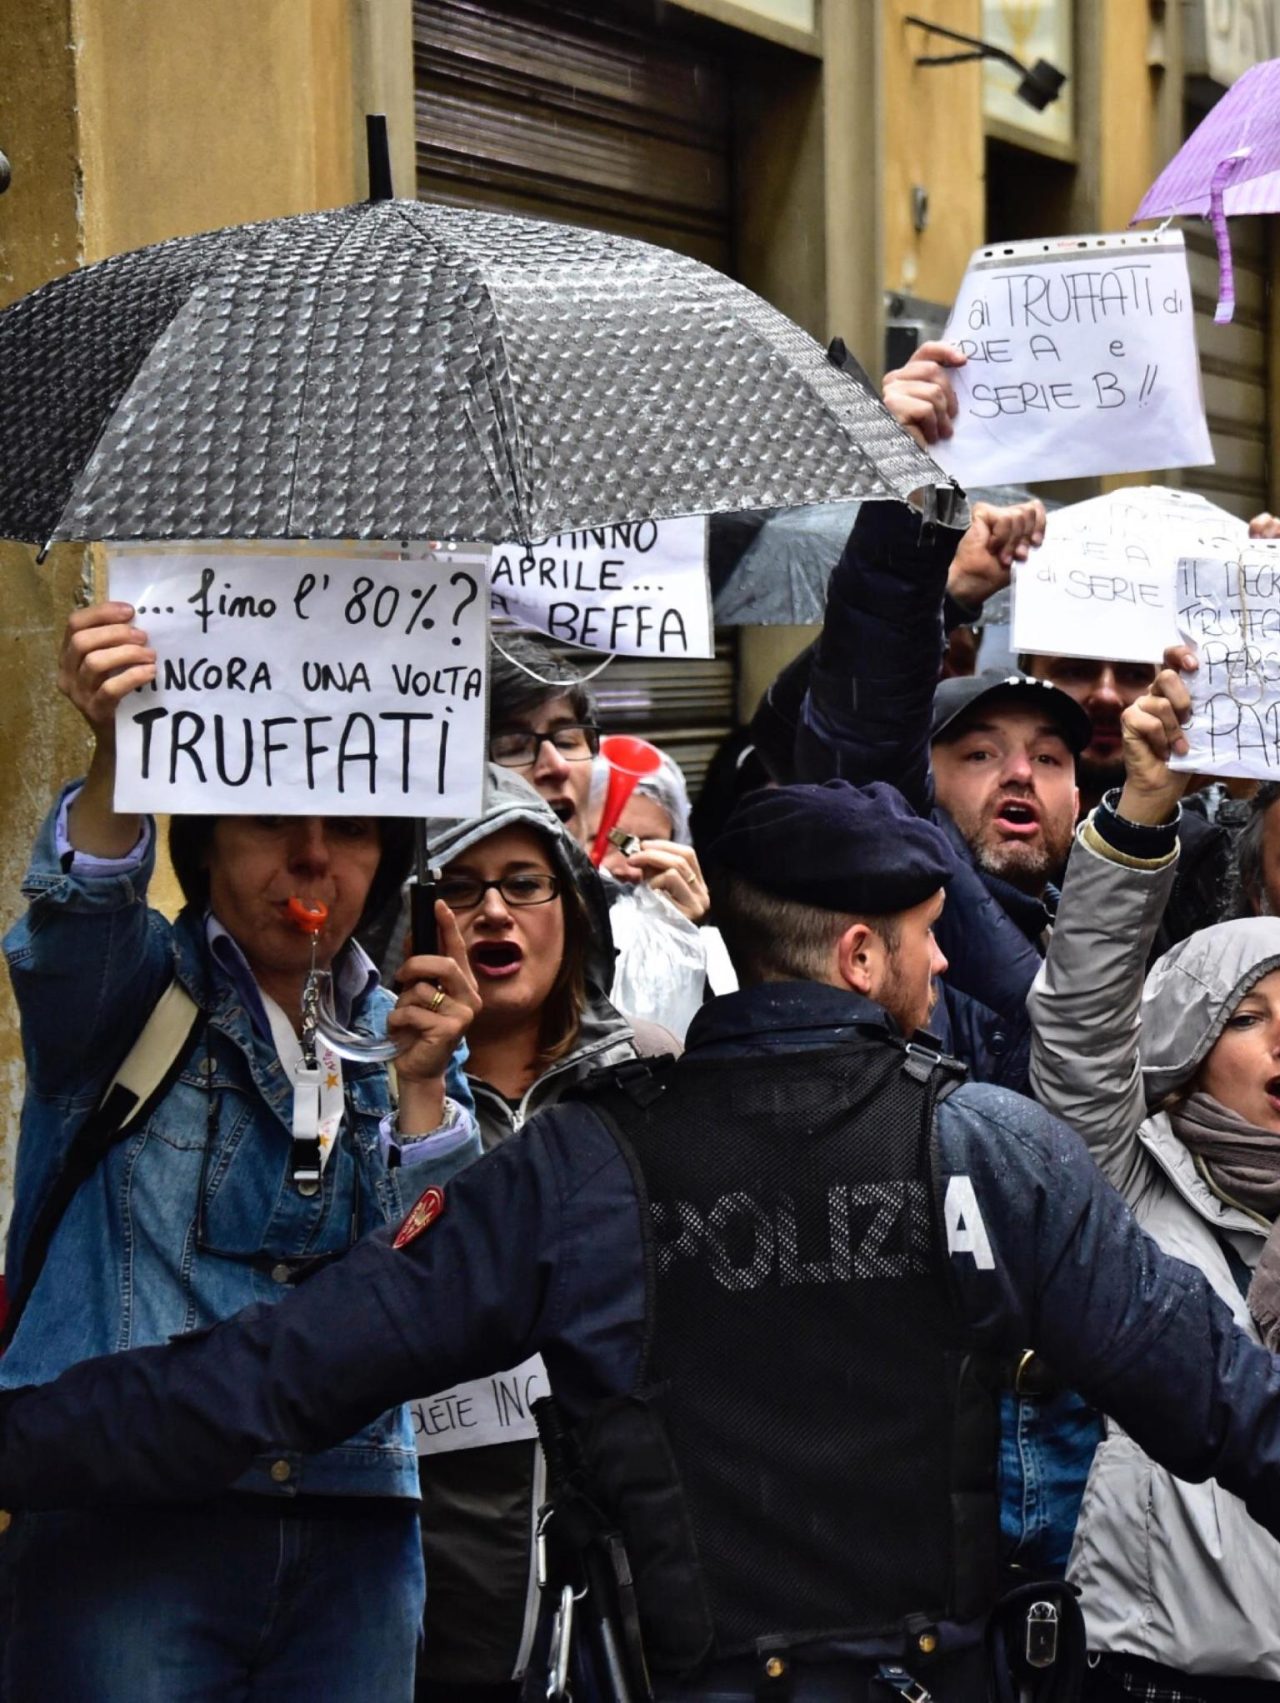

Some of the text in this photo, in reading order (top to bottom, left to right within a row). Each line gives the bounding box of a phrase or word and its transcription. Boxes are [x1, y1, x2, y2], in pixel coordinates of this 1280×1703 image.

[992, 265, 1152, 327] TRUFFATI
[951, 340, 1013, 363] RIE
[1029, 334, 1061, 361] A
[969, 382, 1080, 418] SERIE
[1064, 570, 1165, 607] SERIE
[1183, 560, 1212, 598] IL
[547, 602, 688, 652] BEFFA
[302, 661, 371, 693] UNA
[391, 663, 482, 701] VOLTA
